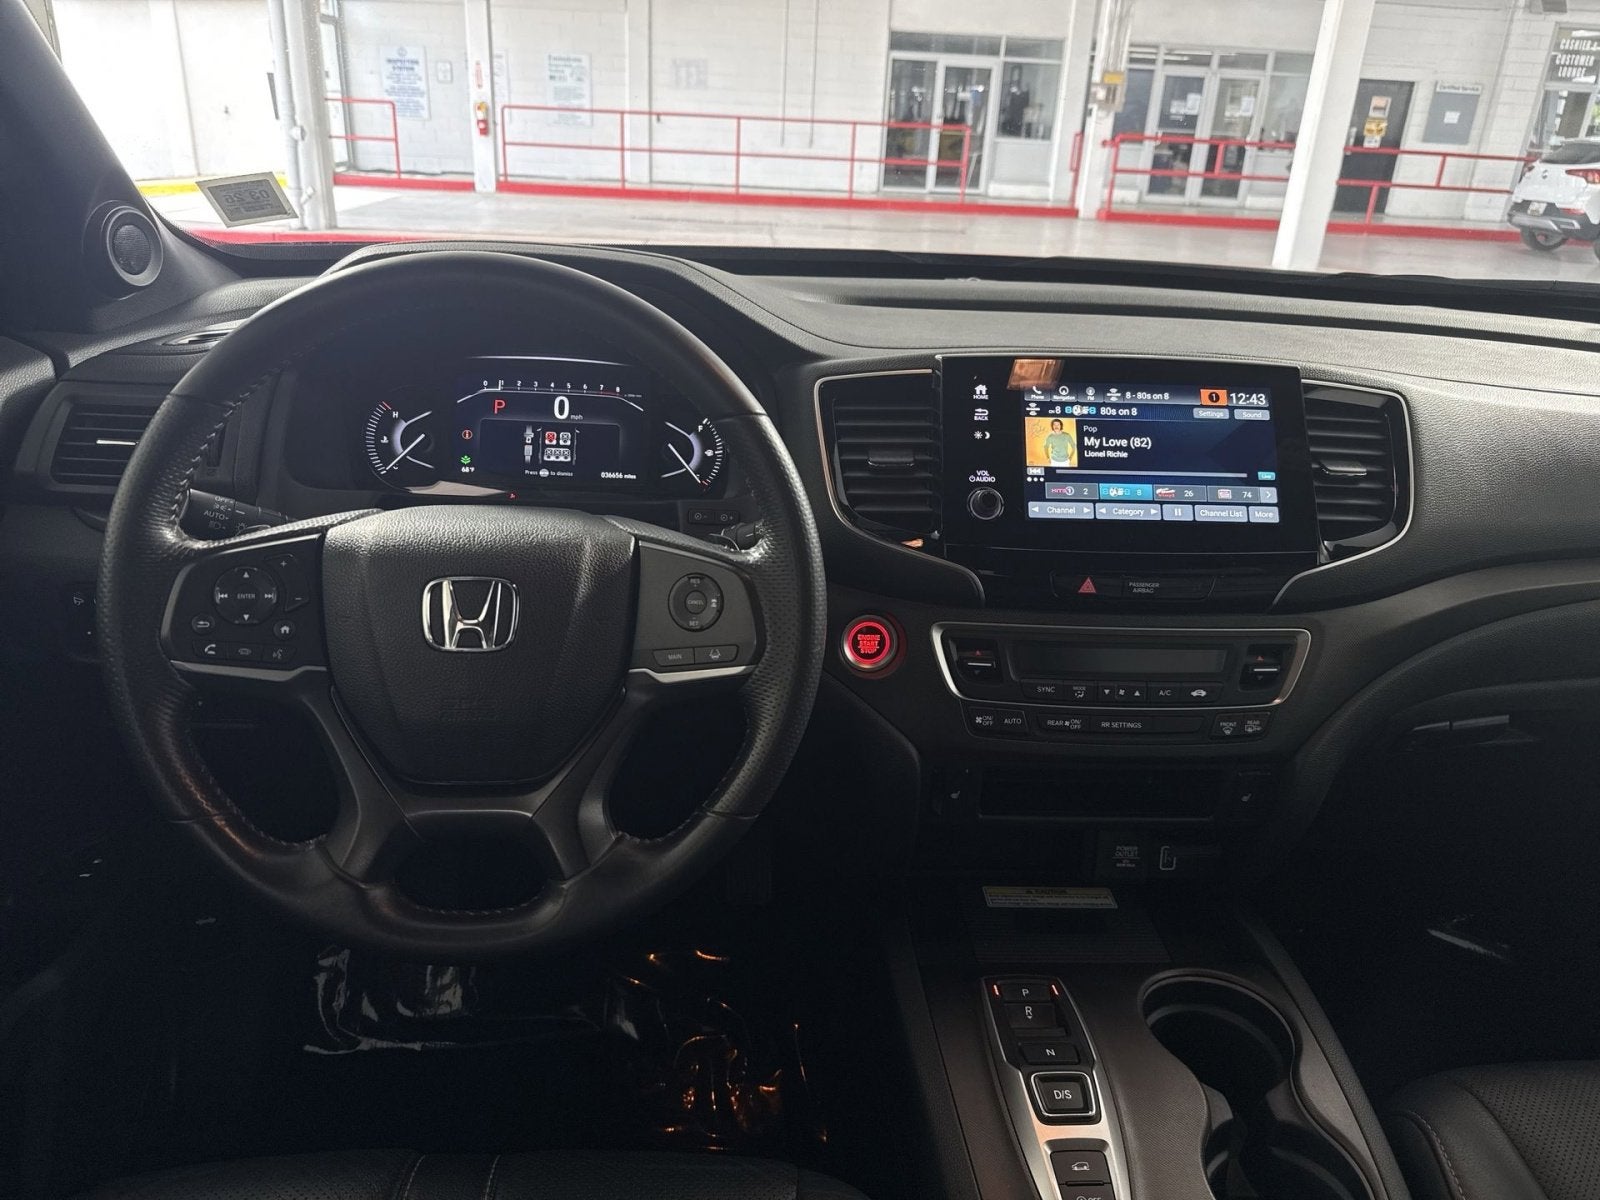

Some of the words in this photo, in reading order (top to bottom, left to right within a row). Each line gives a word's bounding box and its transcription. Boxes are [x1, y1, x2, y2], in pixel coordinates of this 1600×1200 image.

[1560, 39, 1591, 50] CASHIER
[1555, 54, 1595, 66] CUSTOMER
[1558, 66, 1586, 78] LOUNGE
[1125, 391, 1131, 399] 8
[1136, 392, 1151, 400] 80s
[1163, 392, 1170, 400] 8
[1229, 393, 1266, 405] 12:43
[494, 399, 506, 415] P
[553, 395, 570, 420] 0
[1055, 405, 1061, 414] 8
[1100, 407, 1116, 416] 80s
[1131, 408, 1138, 416] 8
[392, 411, 399, 419] H
[1199, 410, 1224, 418] Settings
[1083, 425, 1098, 433] Pop
[1084, 437, 1101, 449] My
[1102, 437, 1128, 447] Love
[1130, 437, 1152, 449] (82)
[1084, 450, 1106, 458] Lionel
[975, 475, 996, 483] AUDIO
[1046, 506, 1076, 514] Channel
[1112, 507, 1145, 517] Category
[1199, 509, 1229, 517] Channel
[1229, 509, 1243, 518] List
[1254, 510, 1274, 519] More
[203, 509, 225, 521] AUTO
[236, 592, 256, 600] ENTER
[668, 653, 682, 661] MAIN
[1111, 721, 1143, 729] SETTINGS
[1021, 988, 1030, 997] P
[1024, 1006, 1033, 1016] R
[1045, 1048, 1056, 1057] N
[1053, 1089, 1072, 1101] D/S
